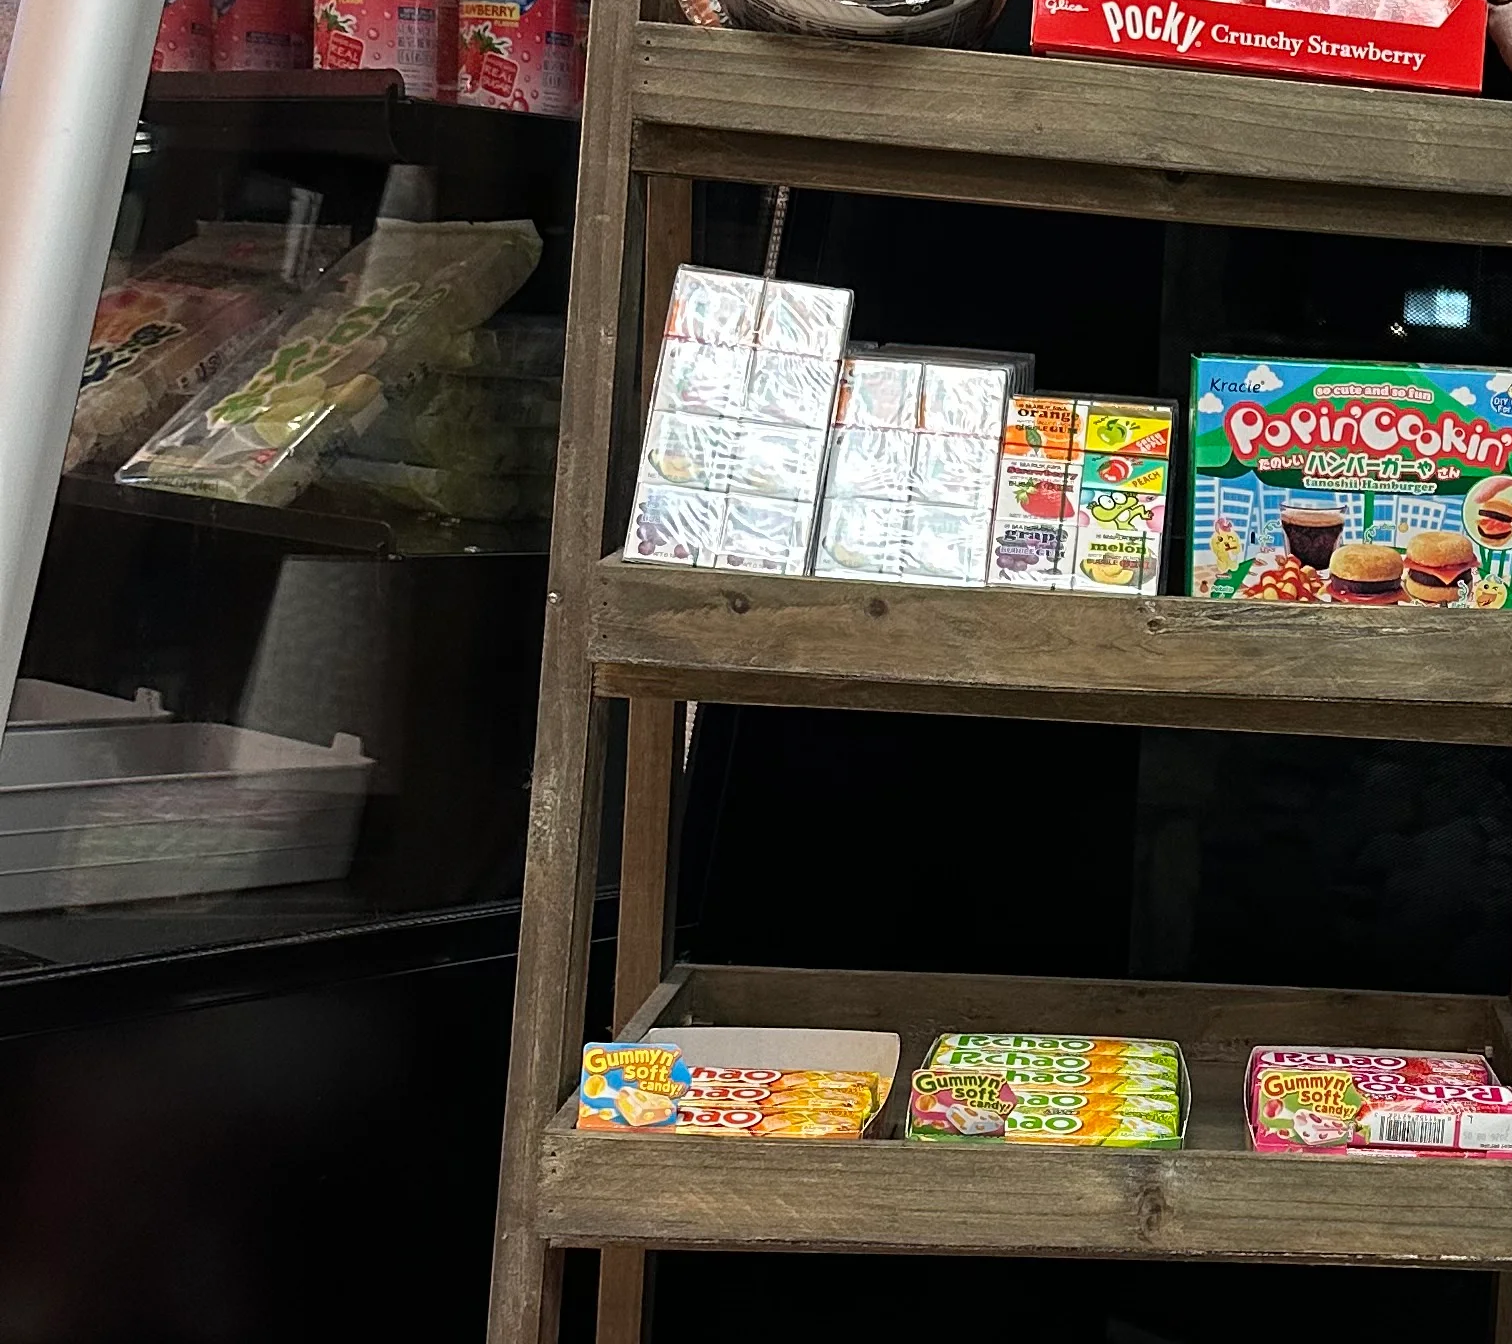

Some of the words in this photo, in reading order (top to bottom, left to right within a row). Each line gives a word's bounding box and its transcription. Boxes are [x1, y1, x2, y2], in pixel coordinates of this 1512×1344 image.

[1102, 0, 1205, 53] Pocky
[1211, 23, 1303, 57] Crunchy
[1307, 34, 1427, 72] Strawberry
[1210, 377, 1261, 394] Kracie
[1316, 387, 1332, 396] so
[1334, 386, 1361, 396] cute
[1364, 386, 1389, 396] and
[1391, 388, 1406, 398] so
[1408, 388, 1432, 402] fun
[1131, 471, 1162, 488] PEACH
[1305, 477, 1359, 489] tanoshii
[1361, 479, 1436, 493] Hamburger
[1090, 542, 1148, 555] melon
[624, 1064, 669, 1081] soft
[639, 1079, 684, 1096] candy!
[955, 1087, 996, 1102] soft
[1301, 1089, 1341, 1104] soft
[970, 1099, 1011, 1114] candy!
[1315, 1104, 1355, 1118] candy!
